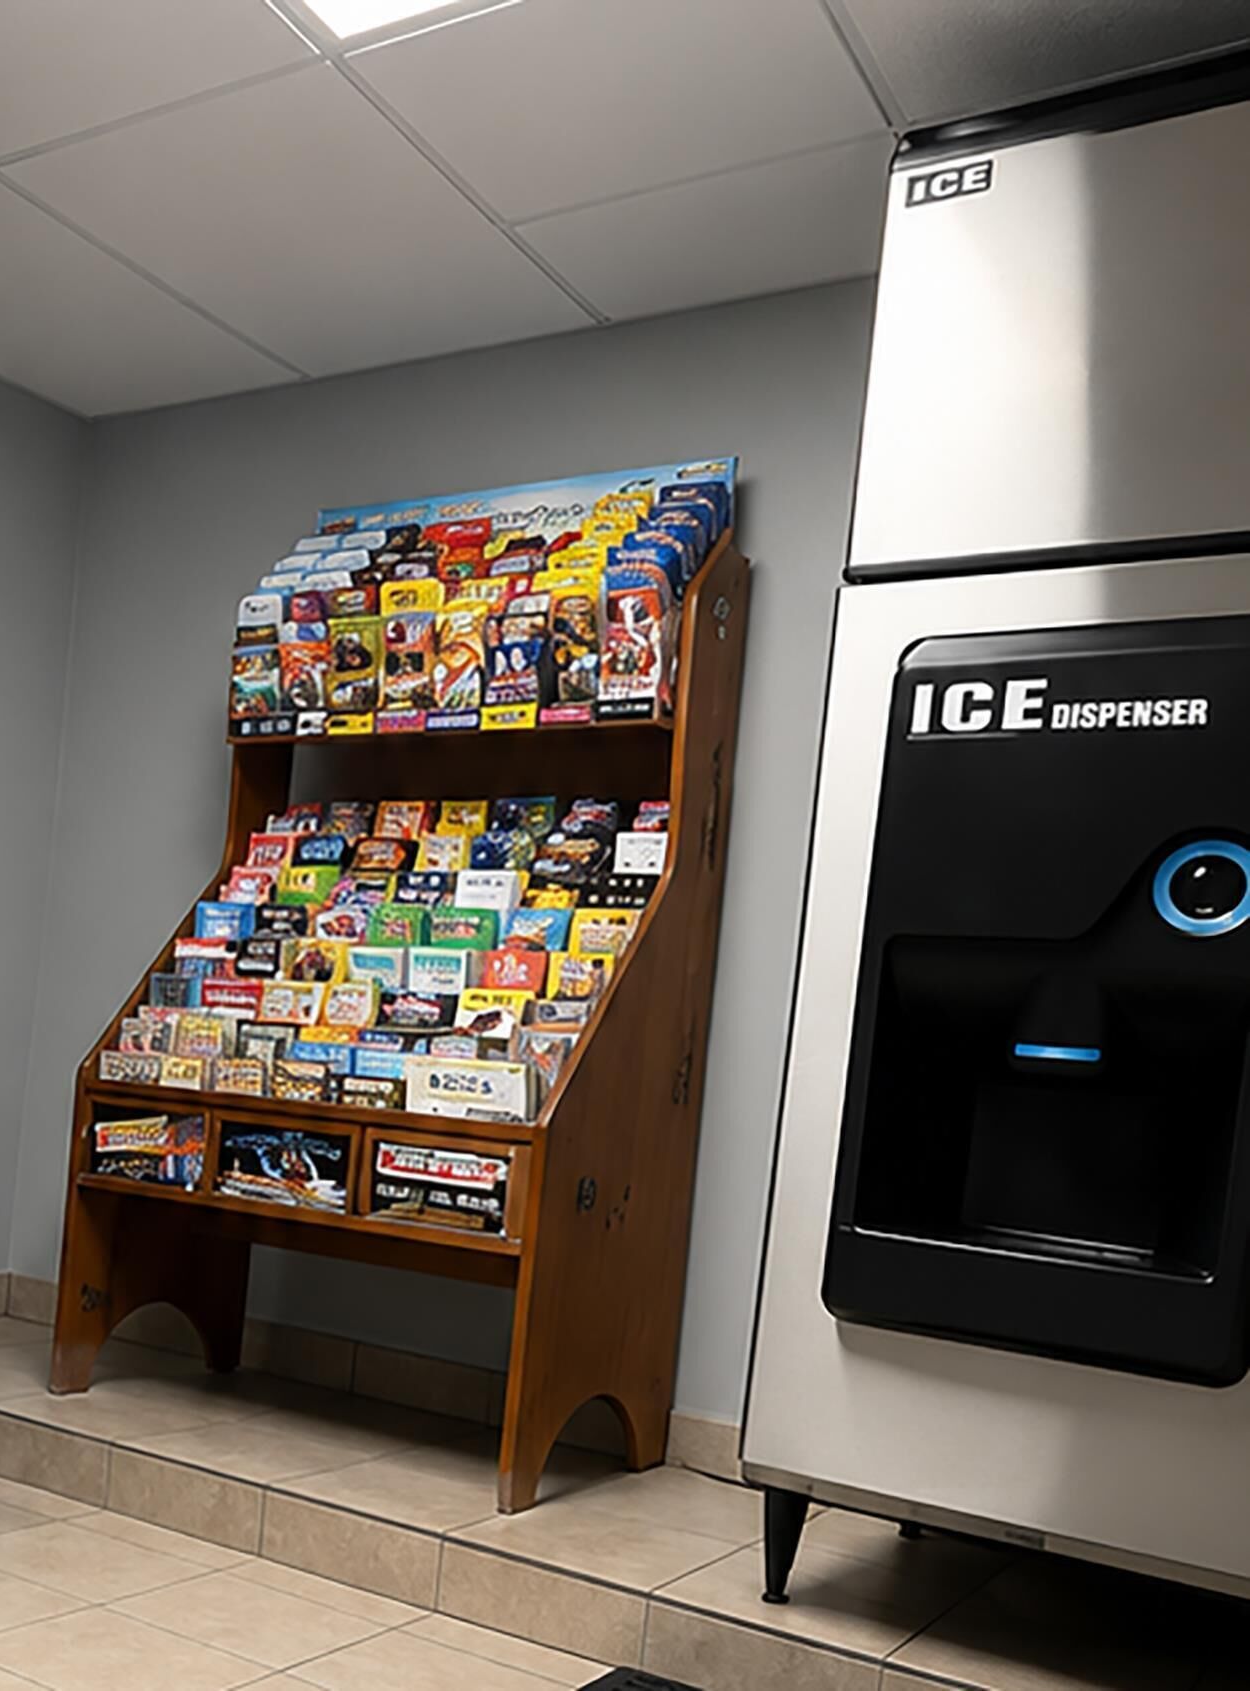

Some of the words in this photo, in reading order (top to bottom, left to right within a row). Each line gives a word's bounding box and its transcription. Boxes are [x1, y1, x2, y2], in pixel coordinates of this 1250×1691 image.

[911, 163, 990, 202] ICE
[910, 678, 1049, 734] ICE
[1050, 698, 1208, 730] DISPENSER
